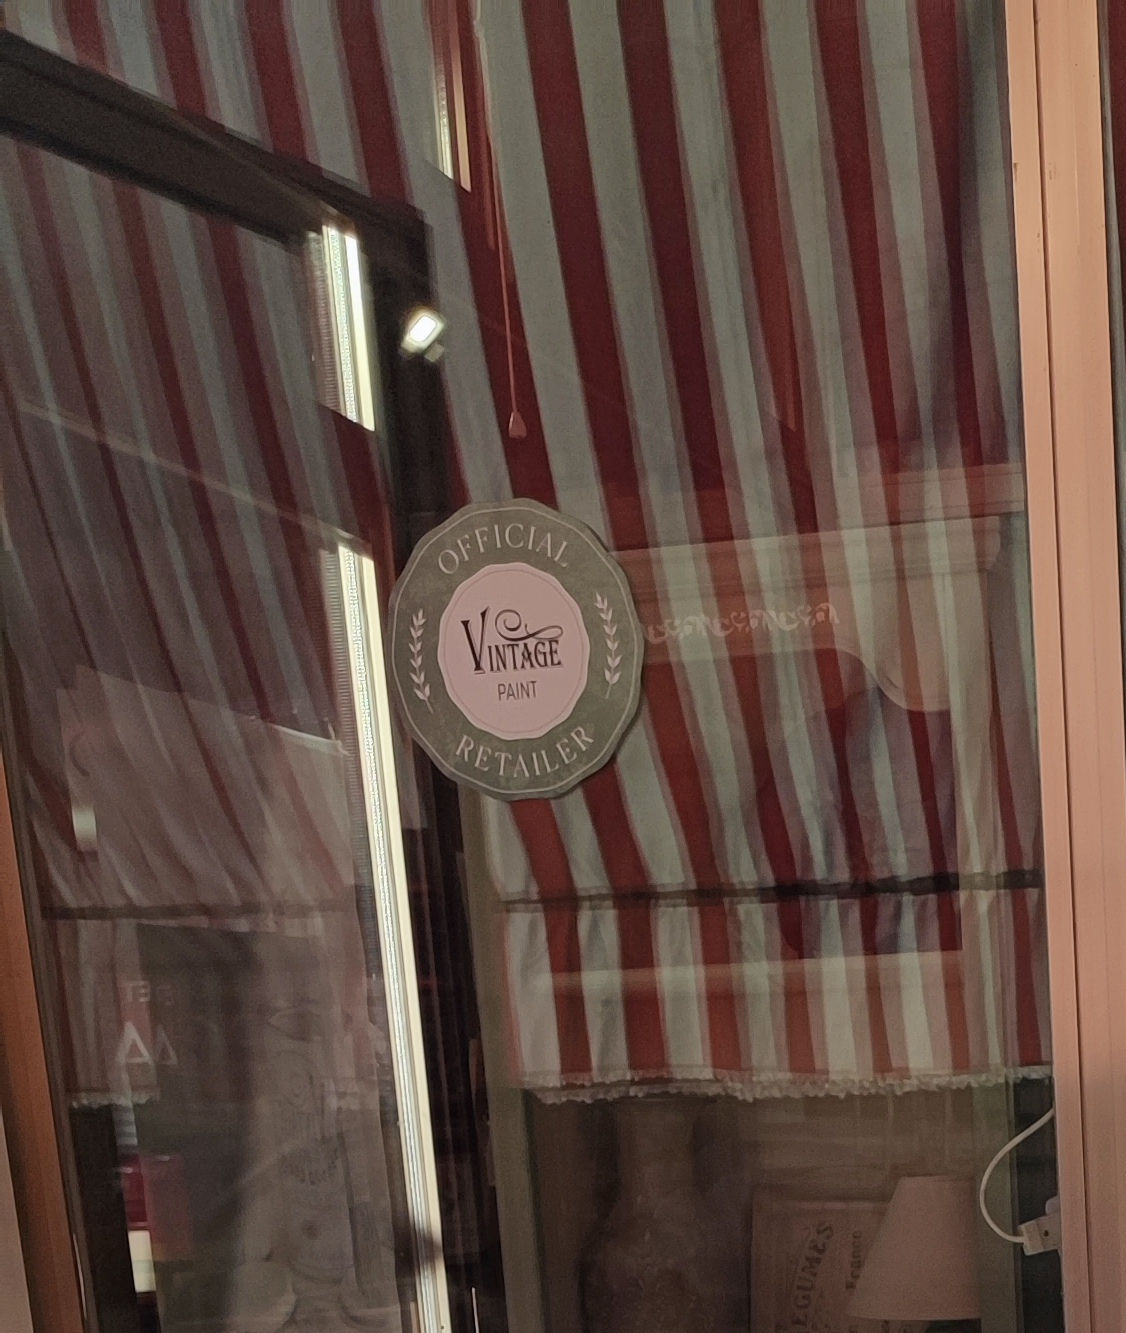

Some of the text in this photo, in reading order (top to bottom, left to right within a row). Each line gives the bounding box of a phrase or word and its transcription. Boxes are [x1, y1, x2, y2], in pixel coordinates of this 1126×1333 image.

[437, 522, 569, 576] OFFICIAL
[497, 680, 538, 701] PAINT
[455, 725, 595, 778] RETAILER
